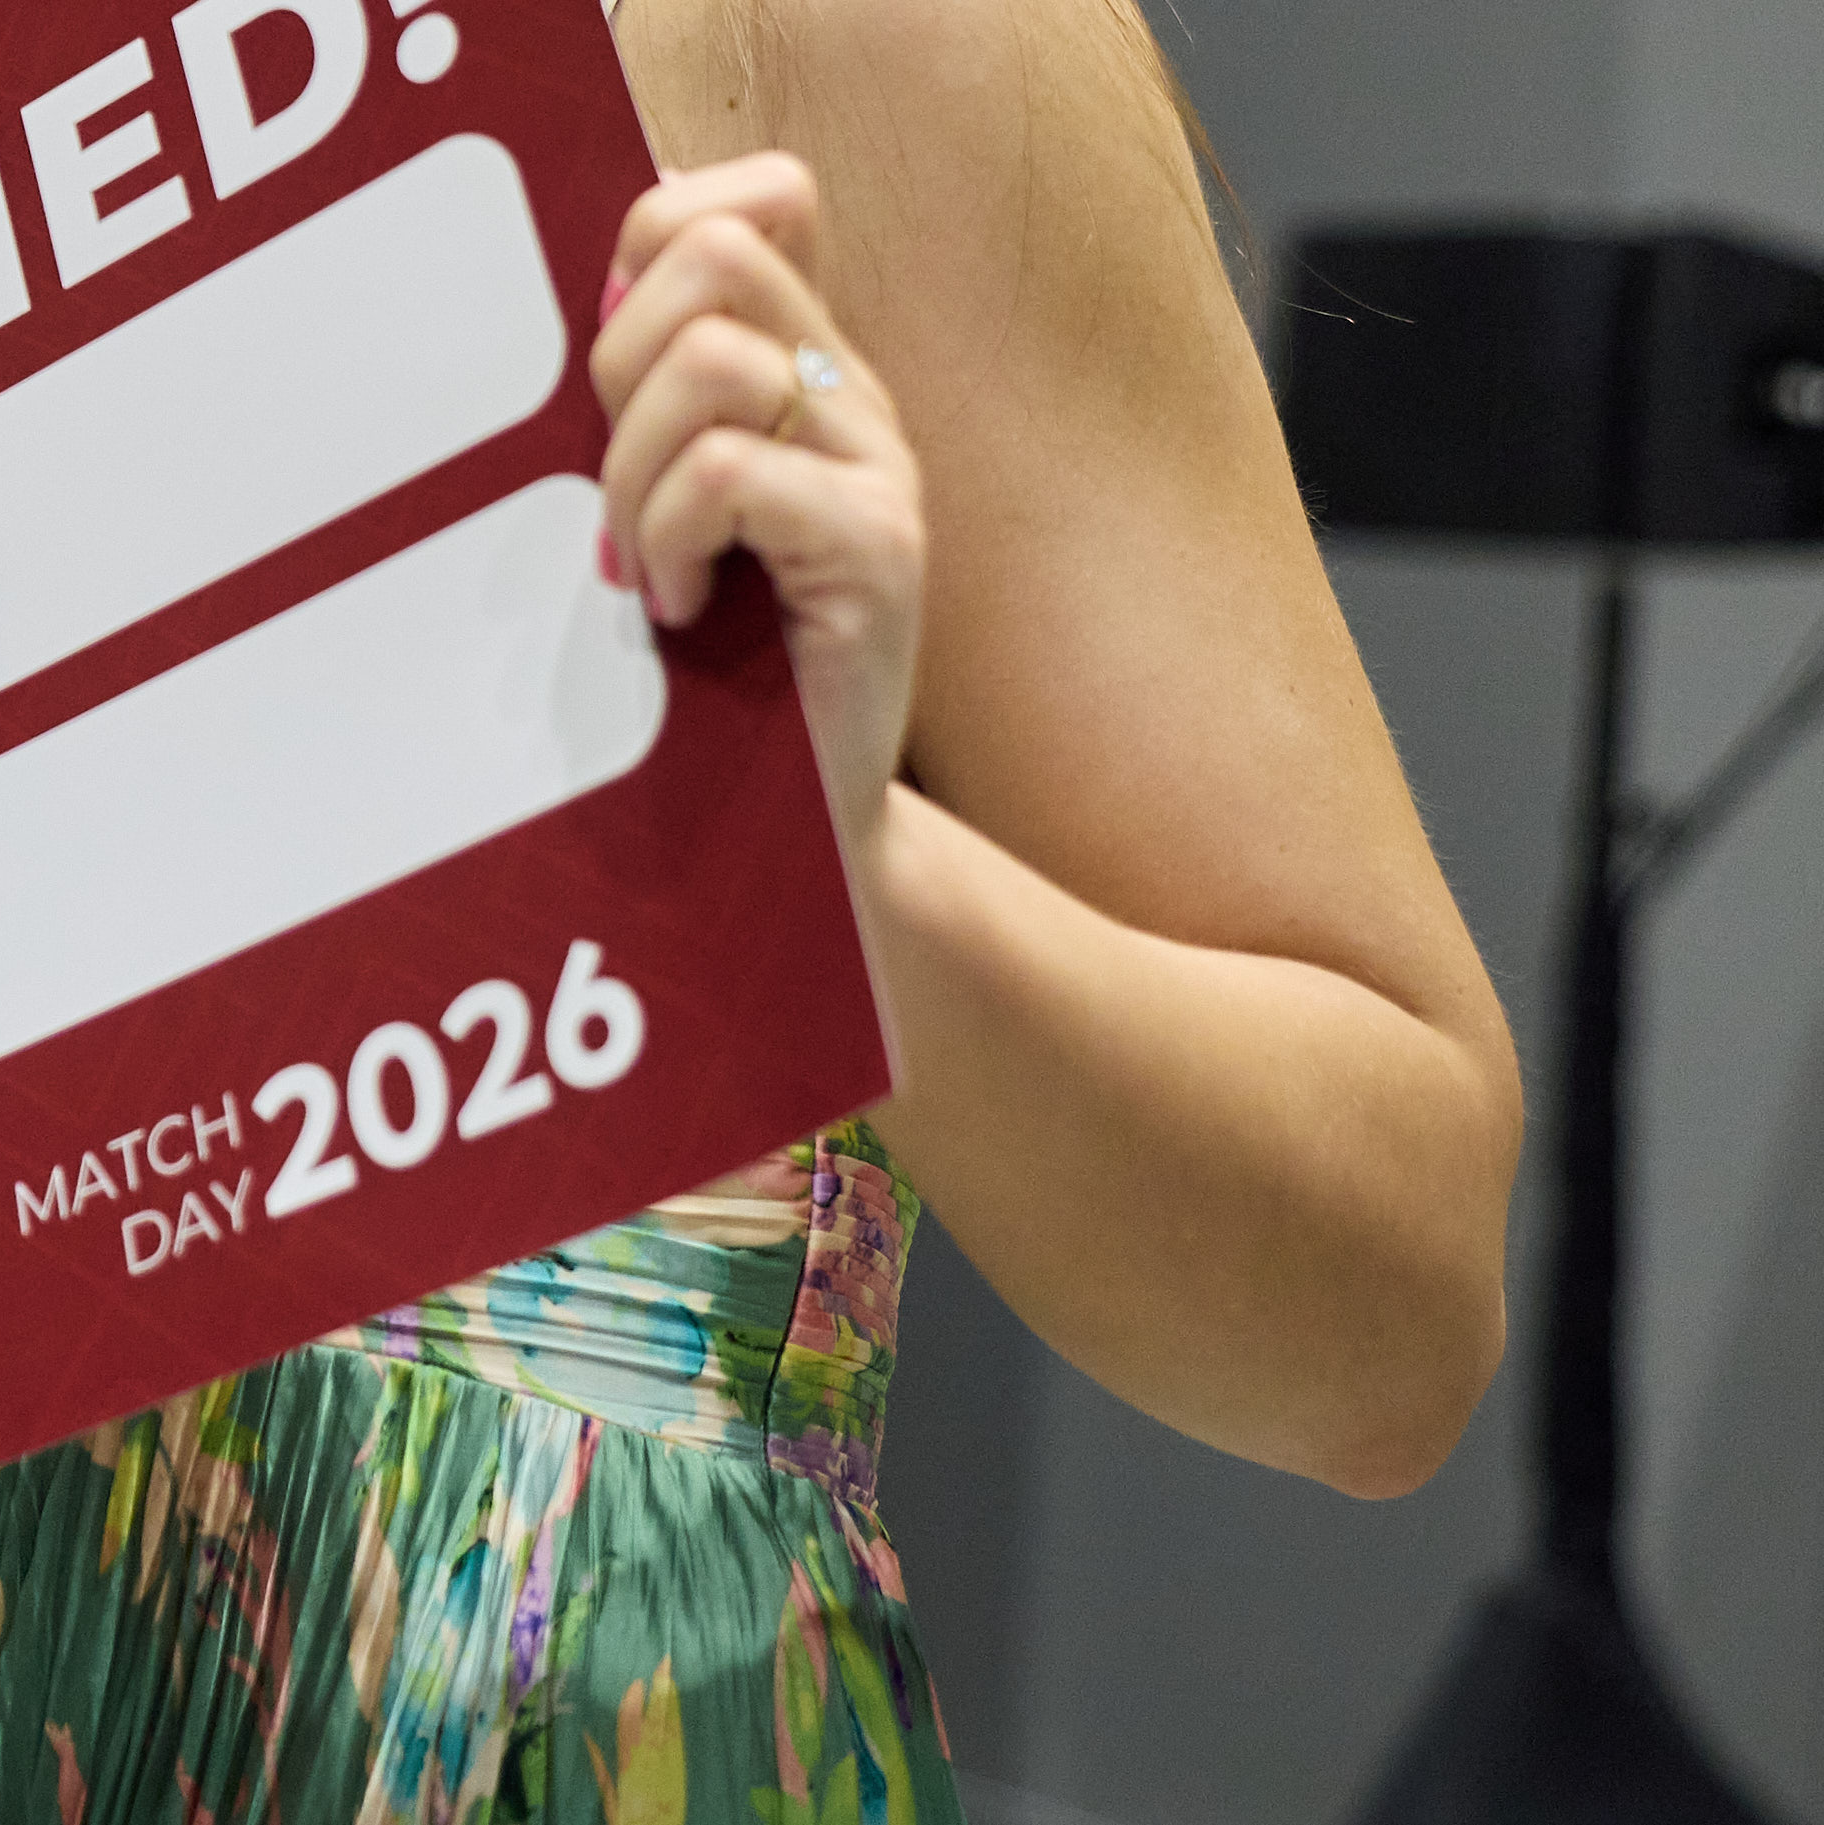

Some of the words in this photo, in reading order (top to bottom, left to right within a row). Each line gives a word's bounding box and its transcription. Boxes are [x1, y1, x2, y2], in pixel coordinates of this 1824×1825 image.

[14, 1093, 241, 1236] MATCH
[121, 1169, 252, 1276] DAY
[251, 939, 644, 1219] 2026
